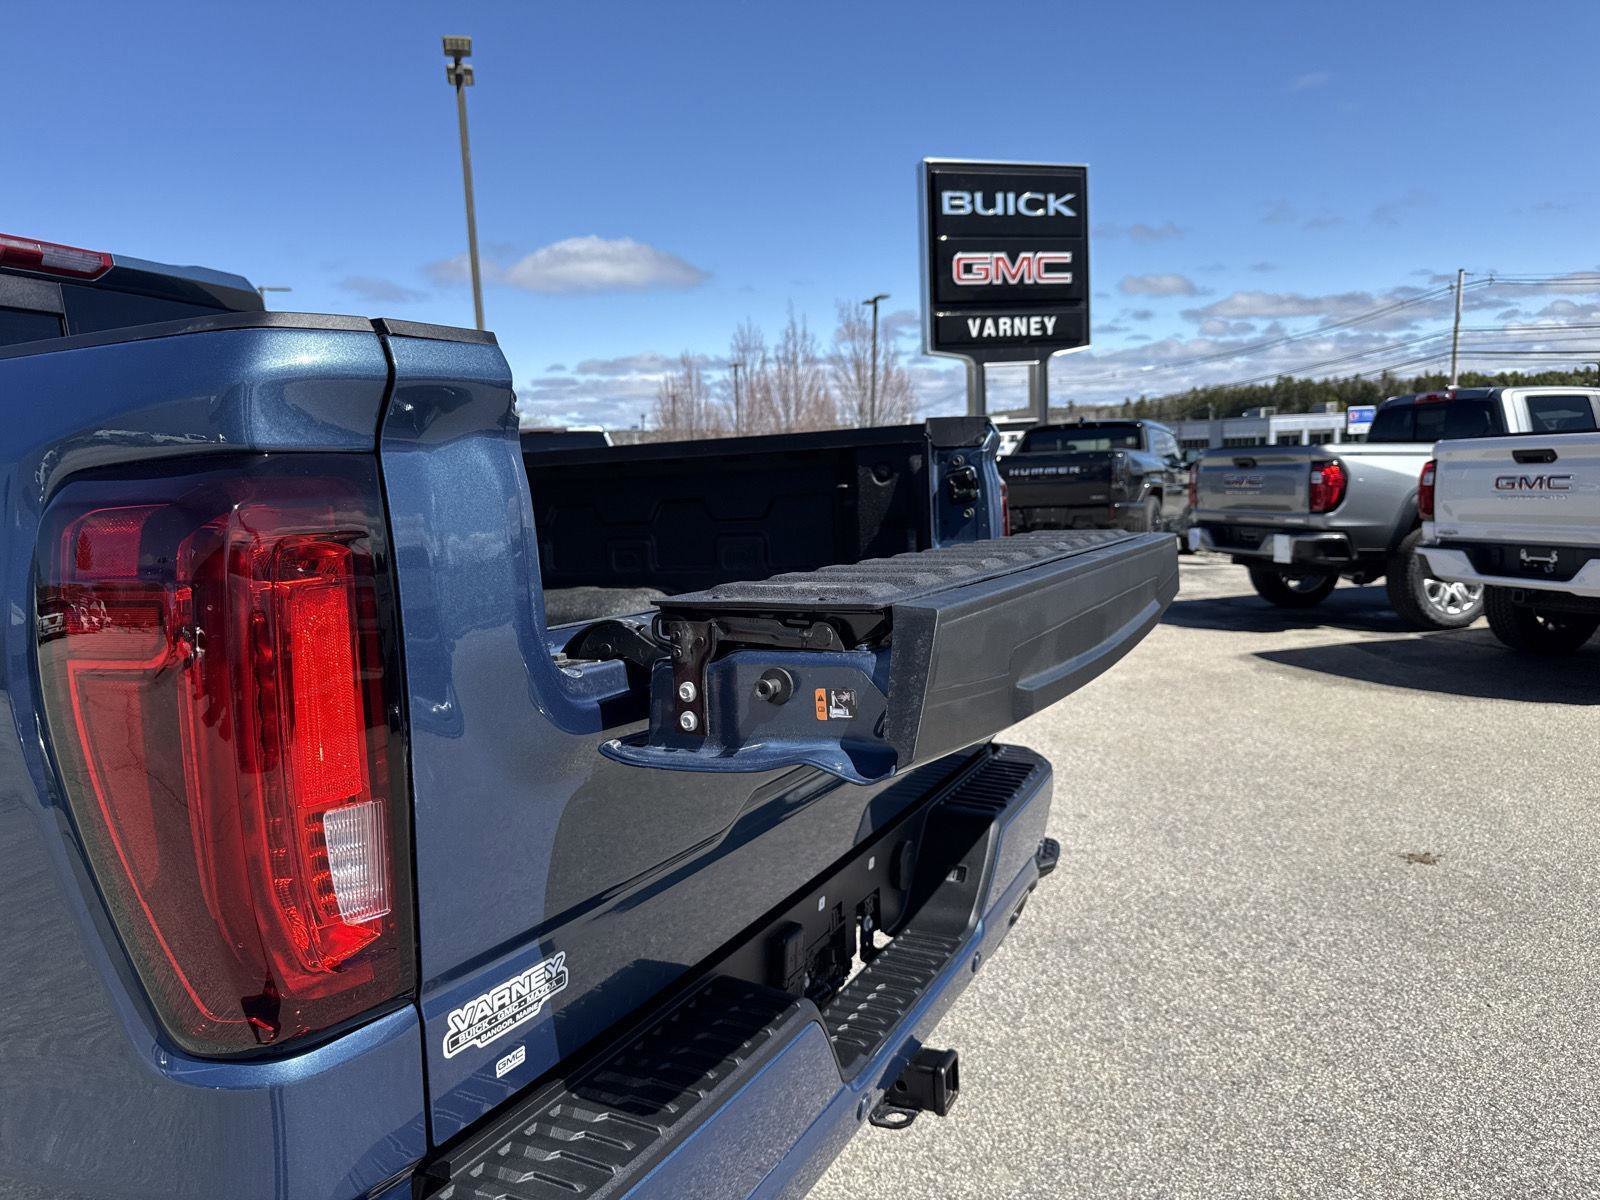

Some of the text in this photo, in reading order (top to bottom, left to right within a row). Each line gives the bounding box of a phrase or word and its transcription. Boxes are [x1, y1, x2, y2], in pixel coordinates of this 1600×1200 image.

[941, 191, 1076, 216] BUICK
[952, 252, 1072, 285] GMC
[967, 316, 1057, 338] VARNEY
[1009, 466, 1080, 476] HUMMER
[1495, 474, 1573, 490] GMC
[450, 954, 564, 1033] VARNEY
[458, 981, 557, 1044] BUICK GMC MAZDA
[480, 1003, 539, 1041] BANGOR, MAINE
[497, 1049, 524, 1070] GMC
